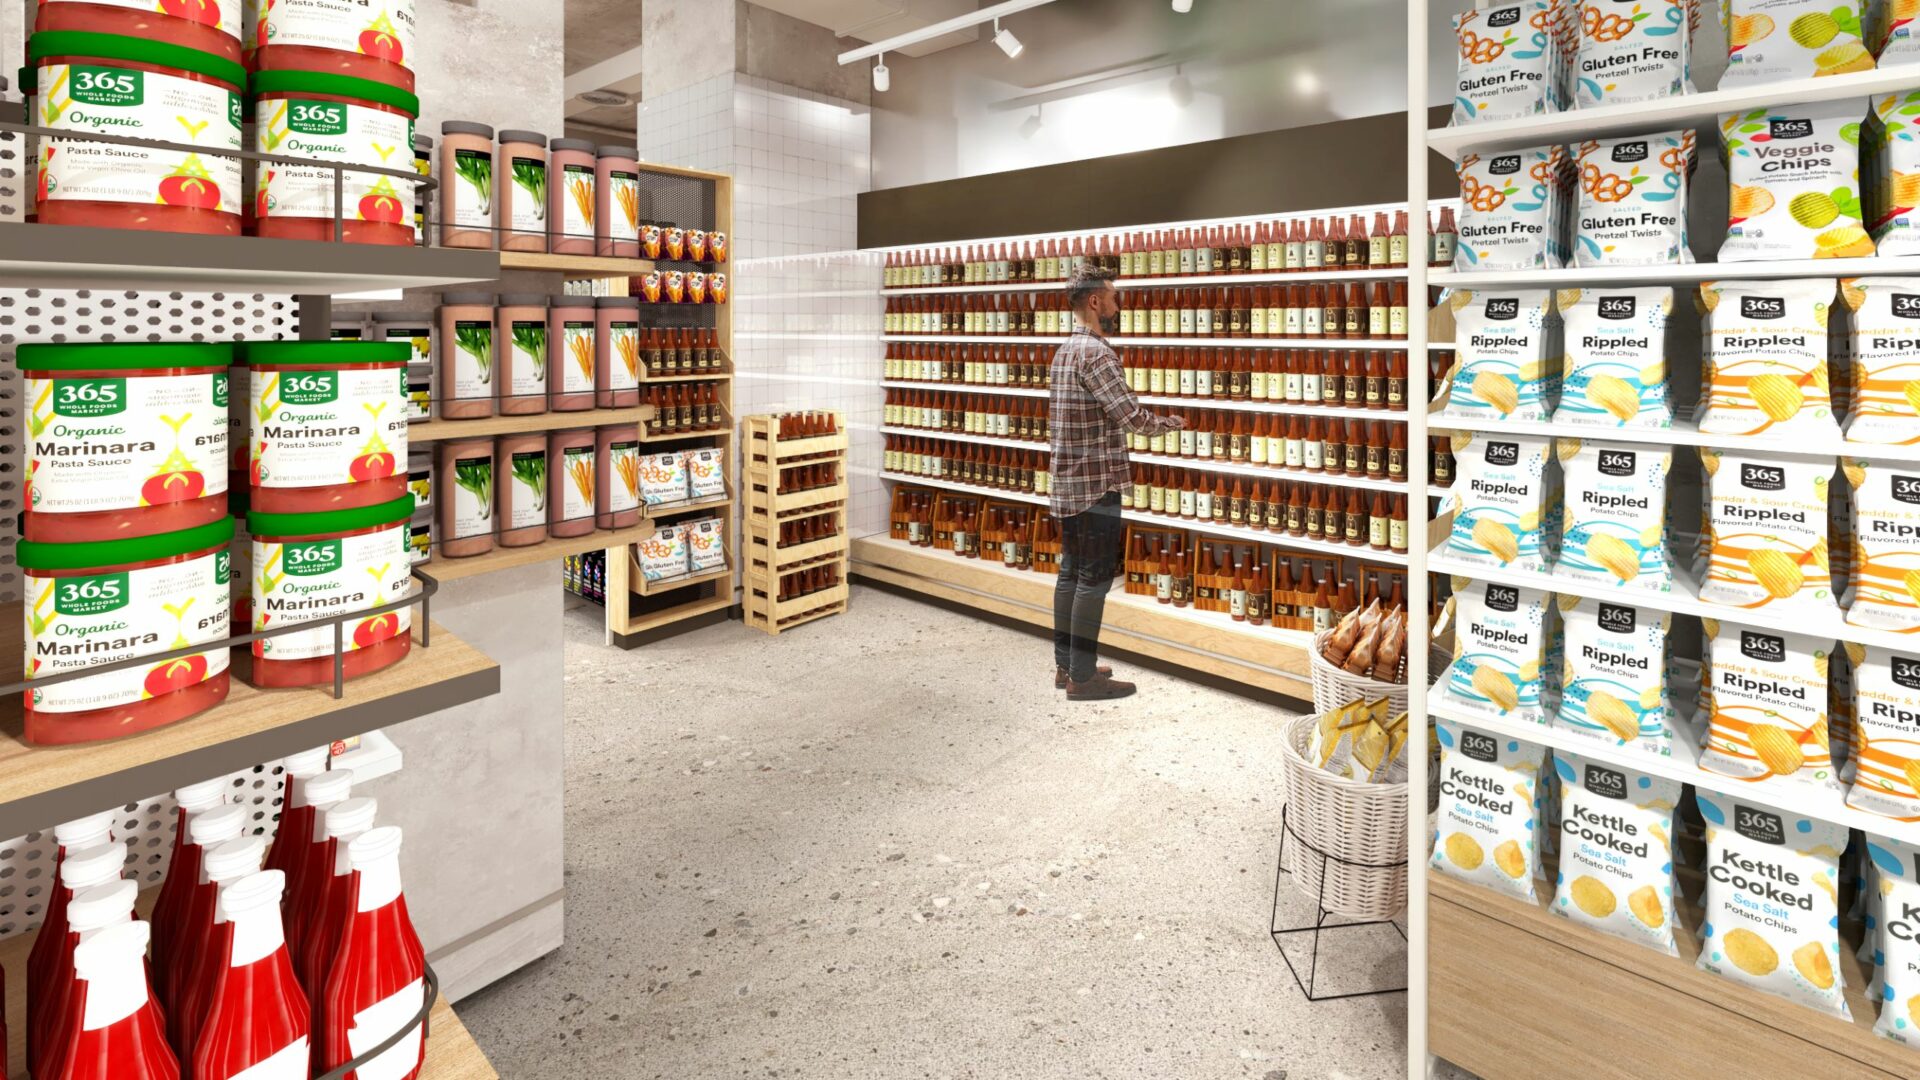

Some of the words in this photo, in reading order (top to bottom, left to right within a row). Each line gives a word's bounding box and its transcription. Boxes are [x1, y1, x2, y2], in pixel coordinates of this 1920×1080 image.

[318, 1, 351, 12] Sauce
[1490, 10, 1518, 22] 365
[1582, 52, 1638, 72] Gluten
[1643, 47, 1679, 62] Free
[1595, 68, 1630, 80] Pretzel
[1633, 62, 1664, 74] Twists
[75, 72, 135, 93] 365
[1460, 74, 1506, 92] Gluten
[1510, 70, 1543, 82] Free
[1470, 87, 1499, 99] Pretzel
[1501, 84, 1528, 93] Twists
[70, 110, 144, 128] Organic
[292, 106, 340, 124] 365
[1774, 122, 1807, 132] 365
[67, 146, 101, 156] Pasta
[105, 147, 149, 159] Sauce
[288, 140, 347, 154] Organic
[1616, 144, 1644, 155] 365
[1754, 142, 1834, 158] Veggie
[1492, 157, 1518, 169] 365
[1761, 158, 1832, 172] Chips
[286, 170, 314, 178] Pasta
[1581, 216, 1636, 230] Gluten
[1640, 212, 1676, 226] Free
[1461, 224, 1506, 238] Gluten
[1510, 222, 1543, 234] Free
[1594, 231, 1628, 240] Pretzel
[1630, 229, 1662, 238] Twists
[1472, 238, 1500, 247] Pretzel
[1502, 236, 1528, 244] Twists
[1489, 302, 1515, 312] 365
[1602, 301, 1631, 312] 365
[1745, 300, 1780, 312] 365
[1471, 336, 1528, 348] Rippled
[1582, 336, 1648, 350] Rippled
[1724, 335, 1805, 348] Rippled
[1616, 350, 1639, 358] Chips
[1712, 348, 1753, 357] Flavored
[1788, 348, 1816, 358] Chips
[1860, 350, 1909, 359] Flavored
[284, 376, 332, 393] 365
[60, 383, 118, 404] 365
[280, 411, 338, 424] Organic
[54, 425, 126, 440] Organic
[264, 424, 360, 438] Marinara
[36, 440, 156, 456] Marinara
[308, 440, 342, 448] Sauce
[1489, 445, 1515, 458] 365
[51, 460, 84, 468] Pasta
[88, 458, 132, 467] Sauce
[1602, 454, 1631, 468] 365
[1483, 472, 1500, 480] Sea
[1500, 472, 1516, 481] Salt
[1745, 468, 1780, 482] 365
[1471, 480, 1528, 496] Rippled
[1476, 494, 1498, 502] Potato
[1500, 496, 1518, 504] Chips
[1582, 492, 1648, 509] Rippled
[1590, 507, 1614, 515] Potato
[1616, 510, 1639, 518] Chips
[1724, 505, 1805, 522] Rippled
[1712, 518, 1753, 527] Flavored
[1756, 522, 1786, 530] Potato
[1788, 525, 1816, 535] Chips
[1860, 534, 1910, 544] Flavored
[288, 545, 335, 564] 365
[60, 580, 120, 602] 365
[283, 580, 342, 596] Organic
[1489, 588, 1515, 604] 365
[266, 591, 364, 610] Marinara
[280, 612, 308, 621] Pasta
[312, 608, 346, 619] Sauce
[1483, 616, 1500, 624] Sea
[1500, 619, 1516, 628] Salt
[1602, 608, 1631, 624] 365
[55, 620, 128, 638] Organic
[1471, 623, 1528, 644] Rippled
[37, 631, 158, 656] Marinara
[1476, 640, 1498, 649] Potato
[1500, 644, 1518, 654] Chips
[1597, 638, 1614, 648] Sea
[1617, 642, 1634, 652] Salt
[1745, 636, 1780, 654] 365
[52, 658, 86, 668] Pasta
[90, 652, 135, 665] Sauce
[1582, 645, 1648, 670] Rippled
[1590, 664, 1614, 674] Potato
[1616, 668, 1639, 680] Chips
[1762, 669, 1788, 680] Sour
[1724, 672, 1805, 700] Rippled
[1712, 686, 1753, 699] Flavored
[1756, 695, 1786, 706] Potato
[1788, 701, 1816, 712] Chips
[1860, 716, 1910, 732] Flavored
[1464, 736, 1494, 752] 365
[1450, 768, 1505, 796] Kettle
[1588, 770, 1622, 790] 365
[1440, 781, 1514, 816] Cooked
[1454, 803, 1473, 818] Sea
[1474, 810, 1494, 824] Salt
[1572, 804, 1638, 836] Kettle
[1448, 811, 1474, 827] Potato
[1475, 818, 1499, 834] Chips
[1740, 811, 1779, 834] 365
[1562, 819, 1648, 858] Cooked
[1580, 843, 1602, 858] Sea
[1604, 851, 1626, 867] Salt
[1573, 852, 1603, 870] Potato
[1605, 860, 1634, 880] Chips
[1722, 849, 1800, 886] Kettle
[1710, 865, 1813, 911] Cooked
[1734, 893, 1759, 910] Sea
[1762, 903, 1789, 920] Salt
[1724, 902, 1762, 923] Potato
[1764, 917, 1798, 934] Chips
